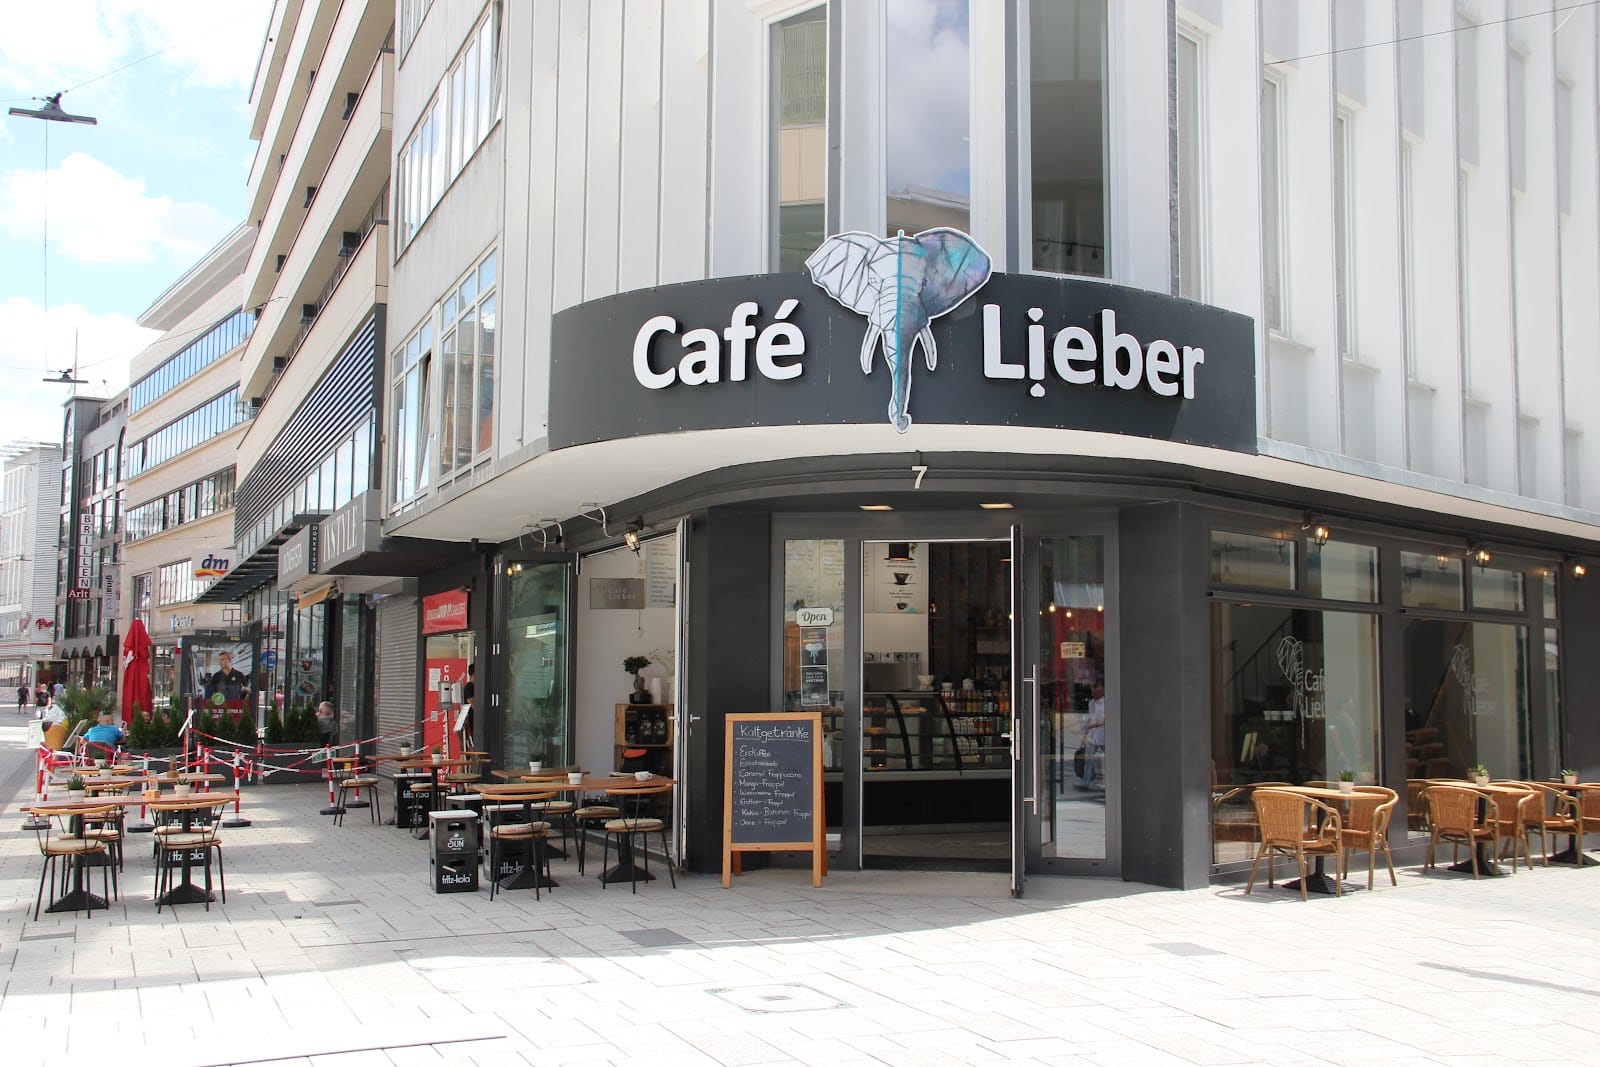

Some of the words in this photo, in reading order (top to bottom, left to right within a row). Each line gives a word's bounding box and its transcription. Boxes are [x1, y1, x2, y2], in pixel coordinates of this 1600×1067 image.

[633, 299, 805, 390] Café
[983, 304, 1204, 399] Lieber
[911, 466, 928, 489] 7
[82, 515, 91, 588] BRILLEN
[202, 554, 229, 570] dm
[69, 589, 89, 598] Arlt
[802, 611, 828, 625] Open
[740, 725, 809, 743] Kaltgetränke
[448, 838, 464, 848] SUN
[442, 874, 471, 884] fritz-kola
